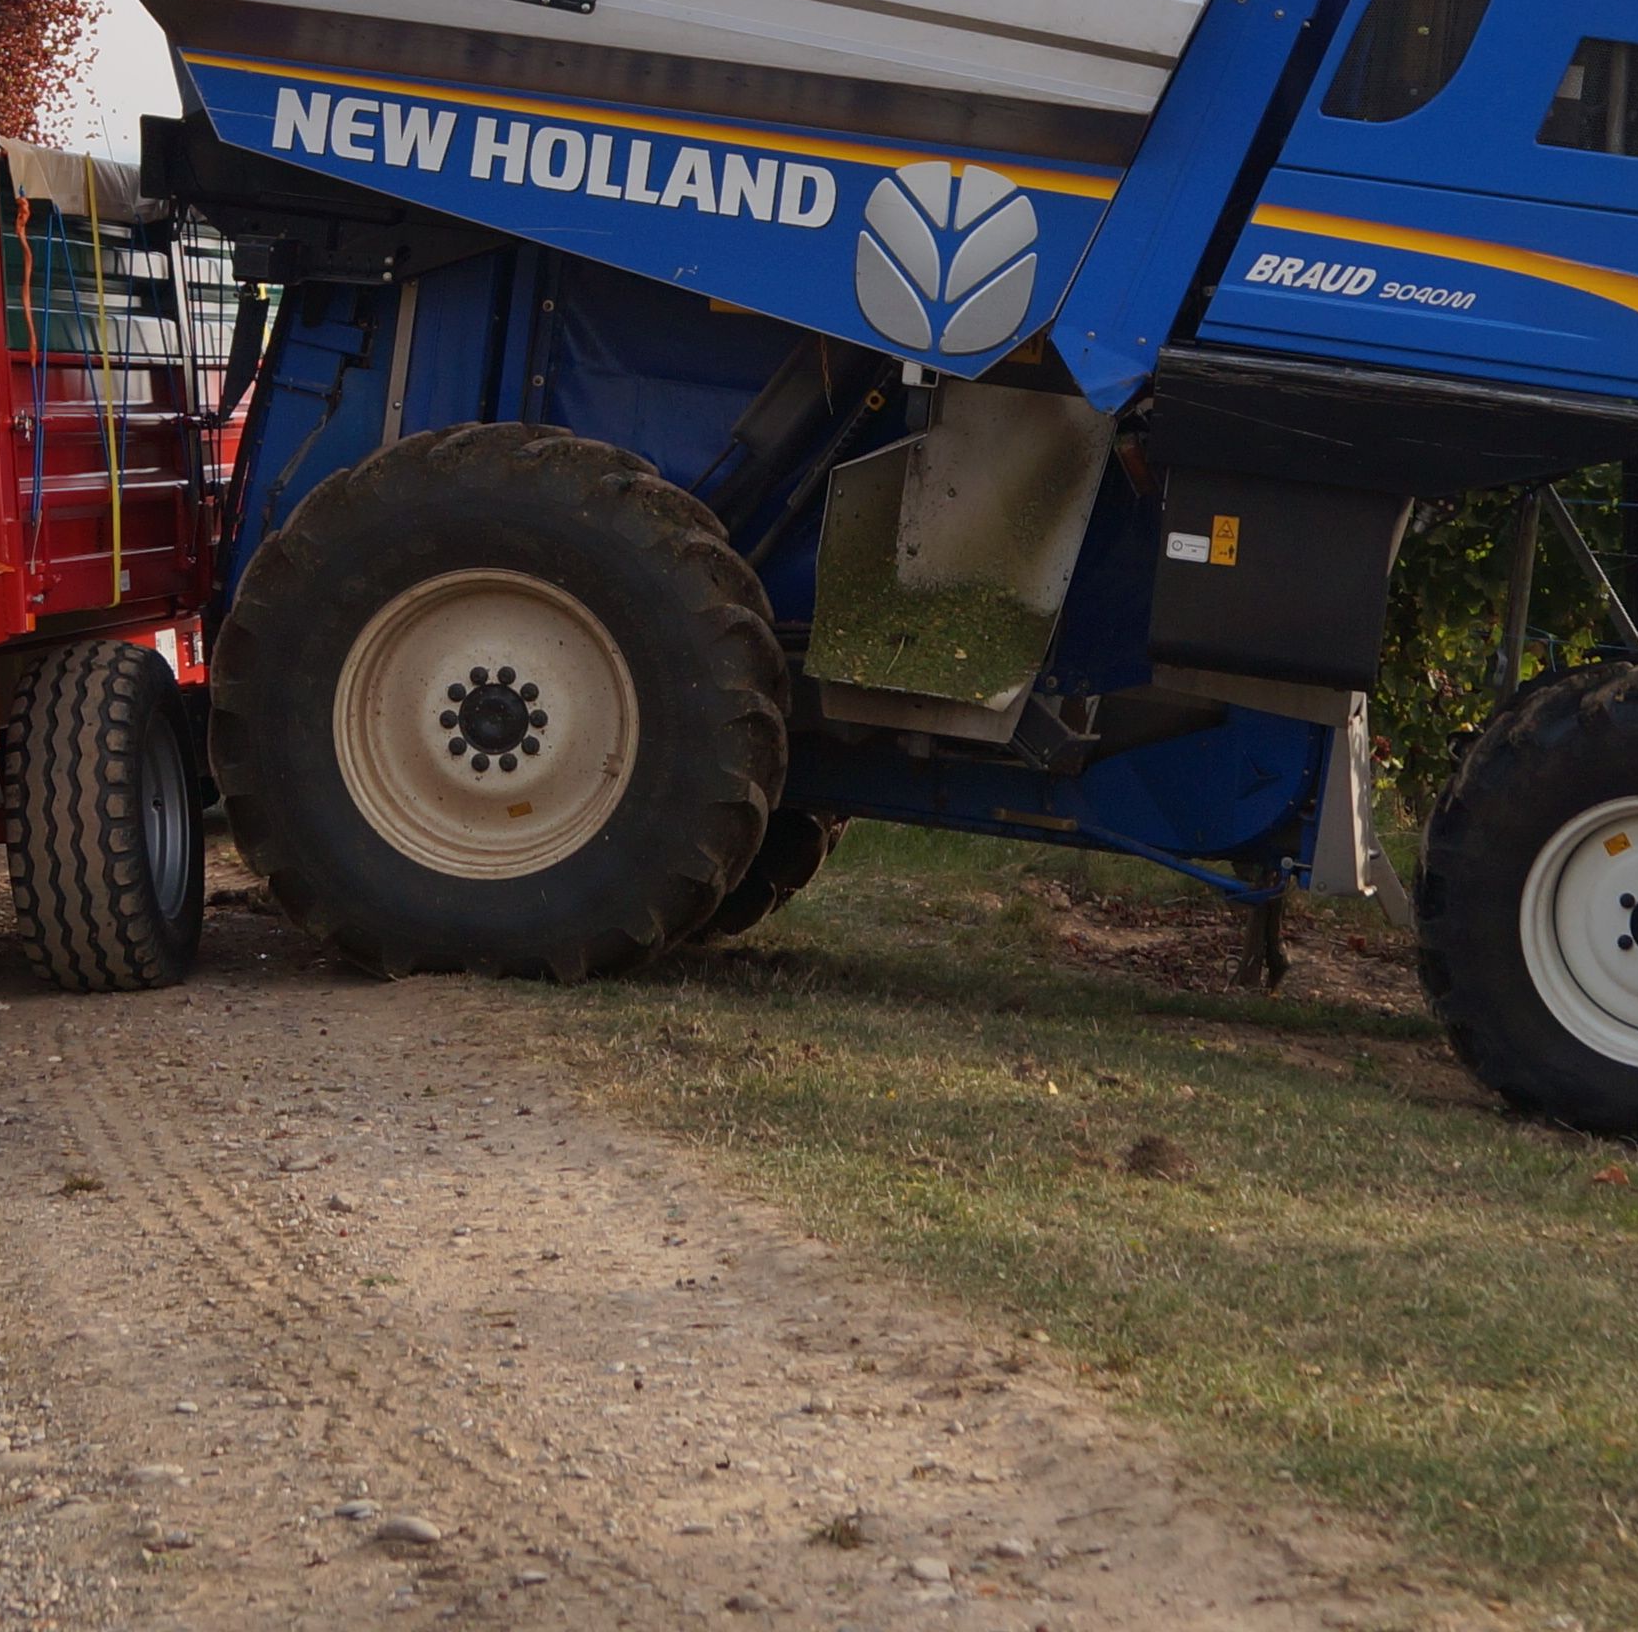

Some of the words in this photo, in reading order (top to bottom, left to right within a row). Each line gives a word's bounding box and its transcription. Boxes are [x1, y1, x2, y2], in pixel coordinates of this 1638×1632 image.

[272, 87, 457, 172] NEW
[470, 117, 837, 228] HOLLAND
[1245, 254, 1377, 296] BRAUD
[1379, 282, 1476, 309] 9040M
